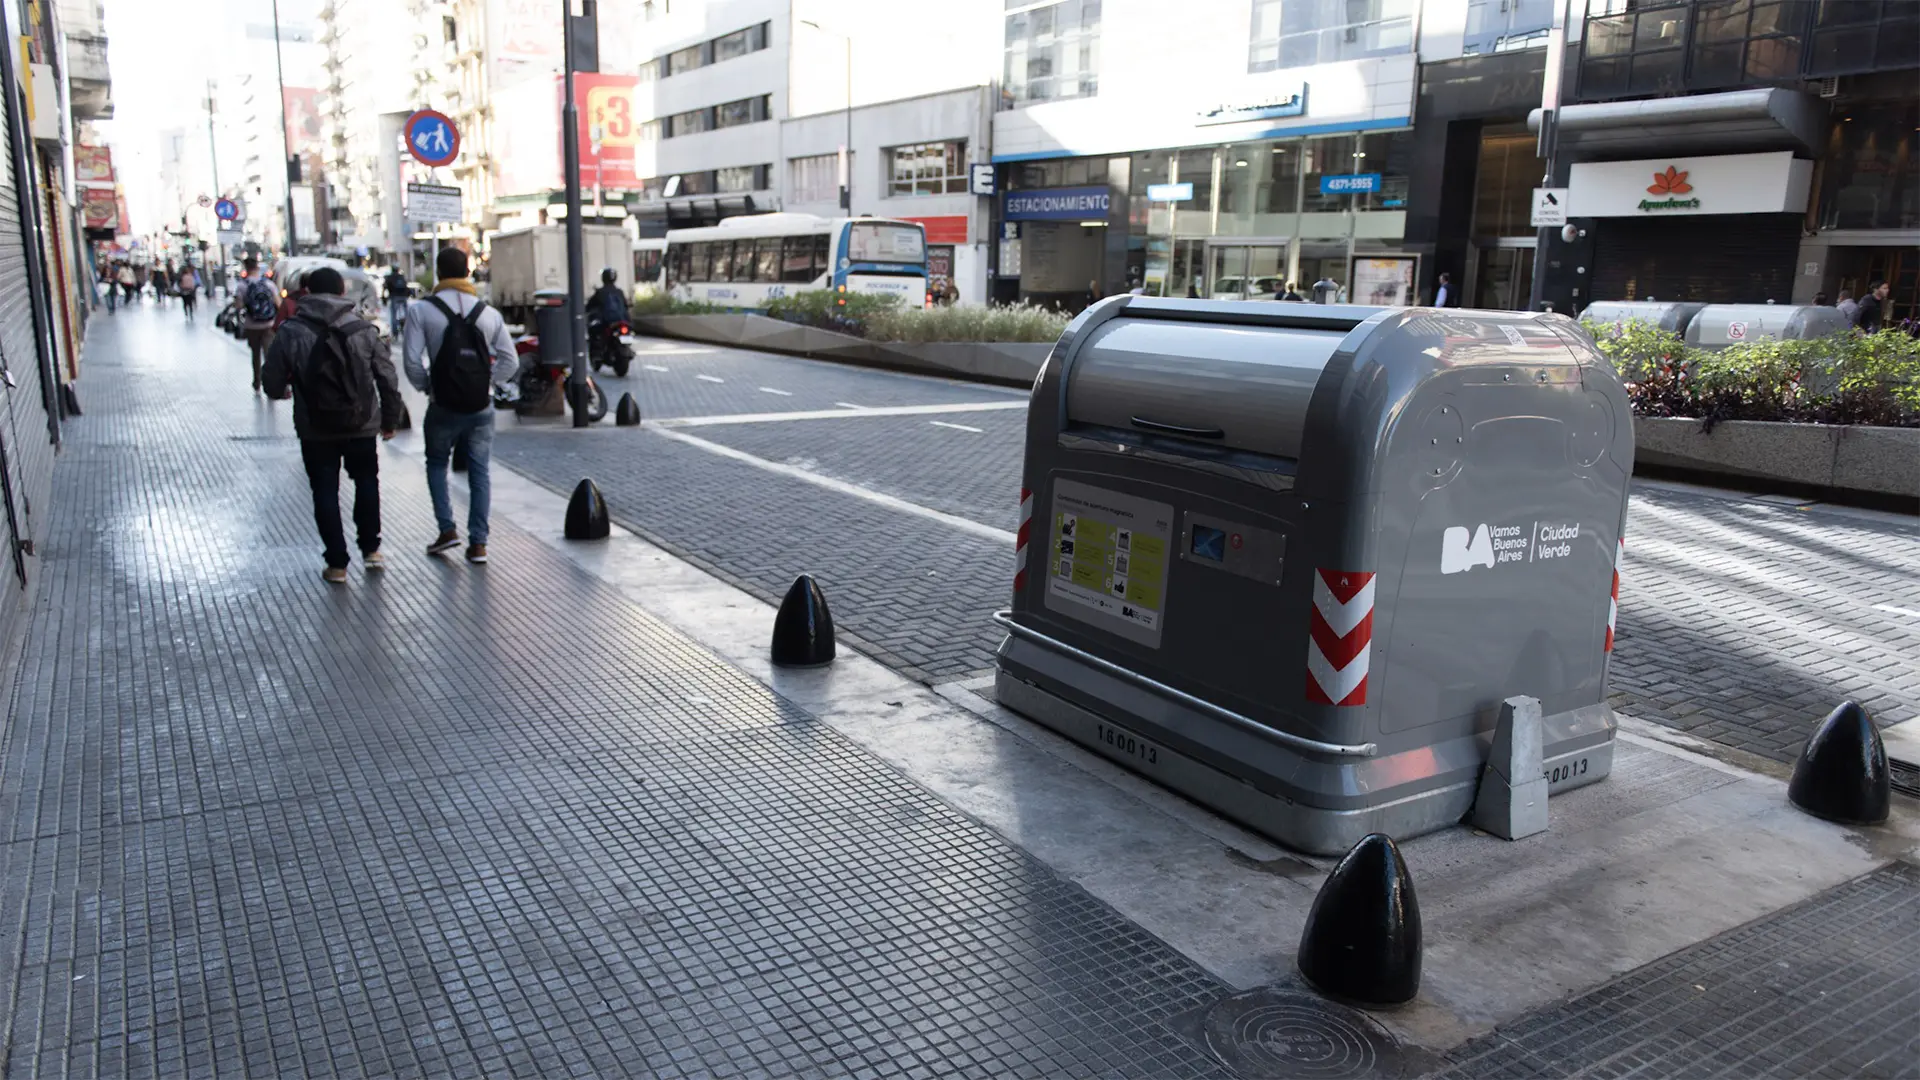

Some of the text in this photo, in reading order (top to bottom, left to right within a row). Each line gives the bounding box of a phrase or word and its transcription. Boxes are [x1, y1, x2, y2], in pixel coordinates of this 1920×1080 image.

[973, 165, 994, 194] E
[1489, 525, 1520, 539] Vamos
[1540, 523, 1580, 542] Ciudad
[1493, 537, 1527, 551] Buenos
[1538, 543, 1571, 560] Verde
[1497, 550, 1523, 563] Aires
